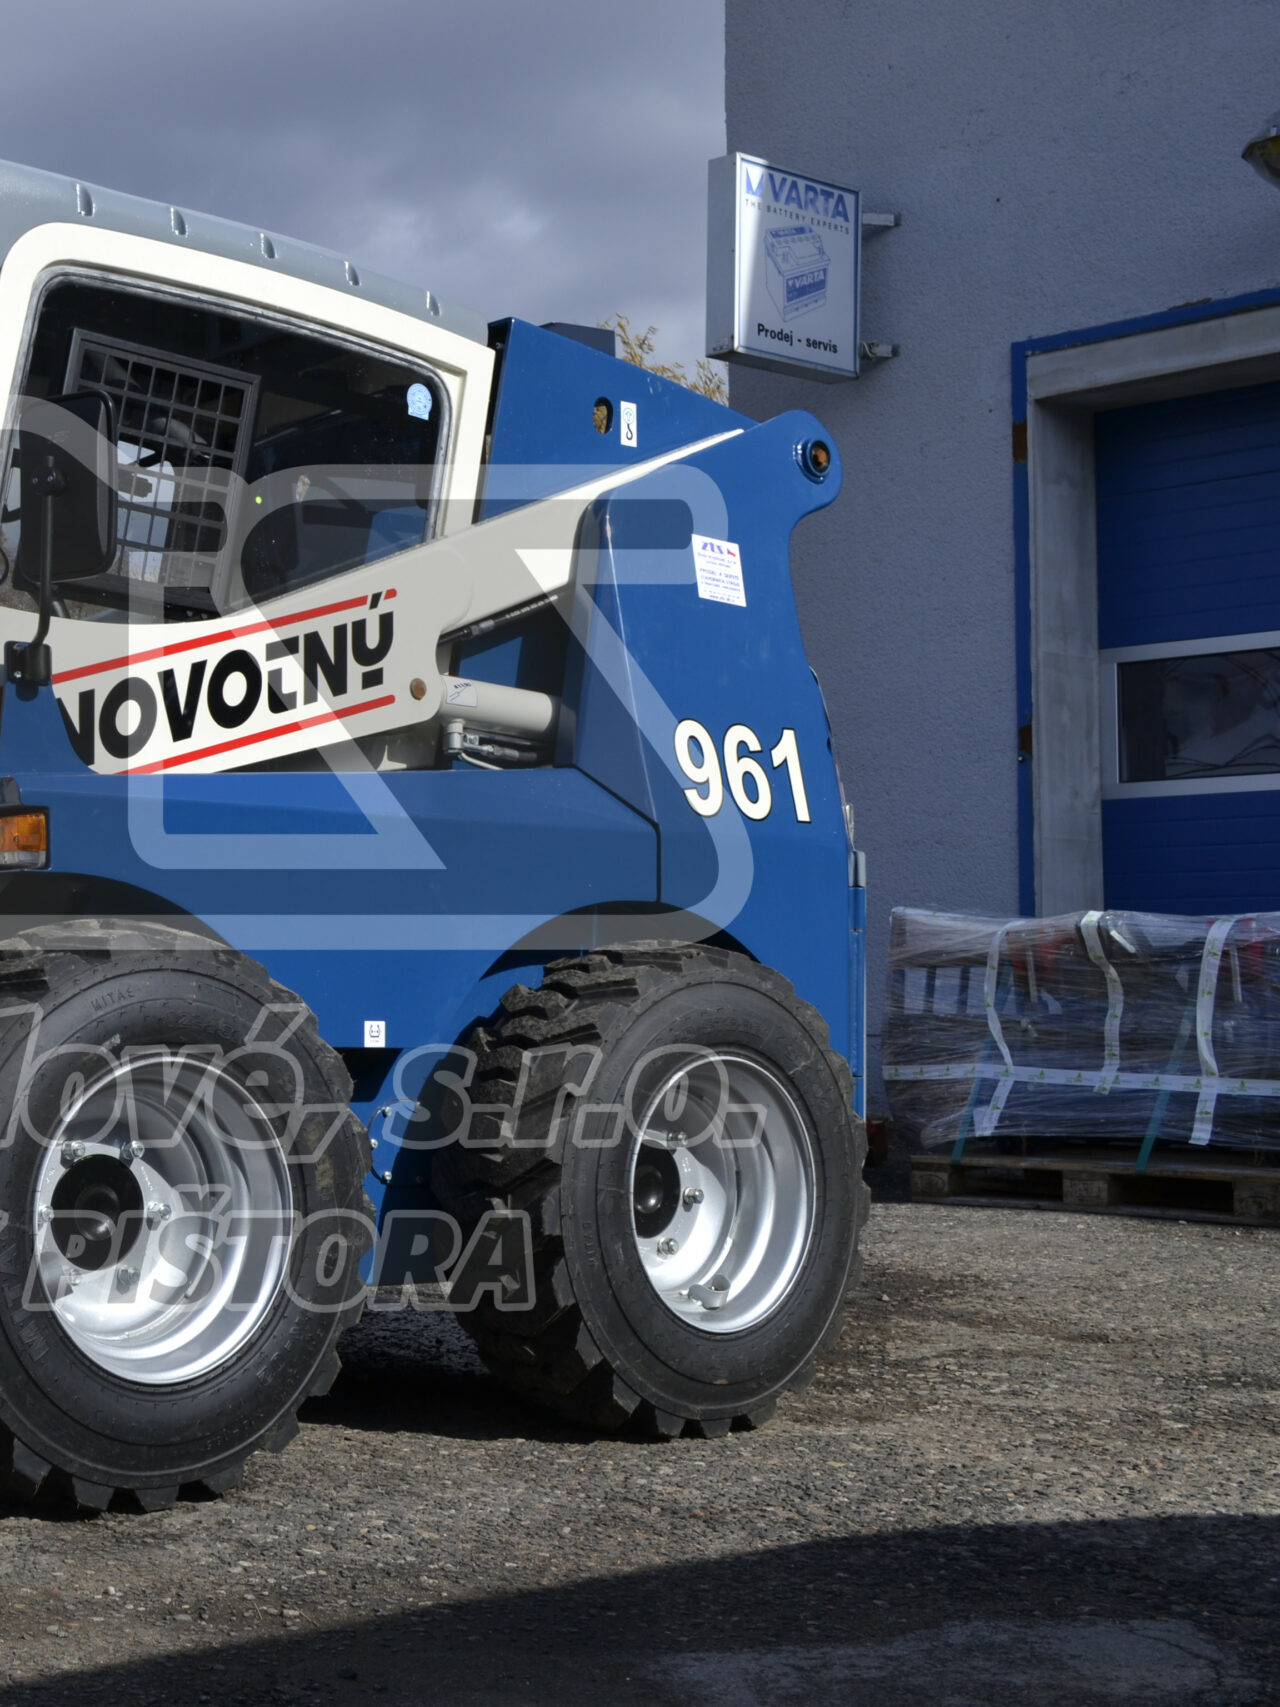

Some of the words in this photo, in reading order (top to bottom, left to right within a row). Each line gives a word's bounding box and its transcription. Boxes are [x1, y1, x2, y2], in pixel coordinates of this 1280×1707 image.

[768, 172, 850, 223] VARTA
[745, 198, 762, 211] THE
[766, 204, 806, 222] BATTERY
[811, 217, 850, 235] EXPERTS
[794, 270, 825, 288] VARTA
[757, 322, 794, 346] Prodej
[806, 337, 839, 354] servis
[674, 718, 812, 823] 961
